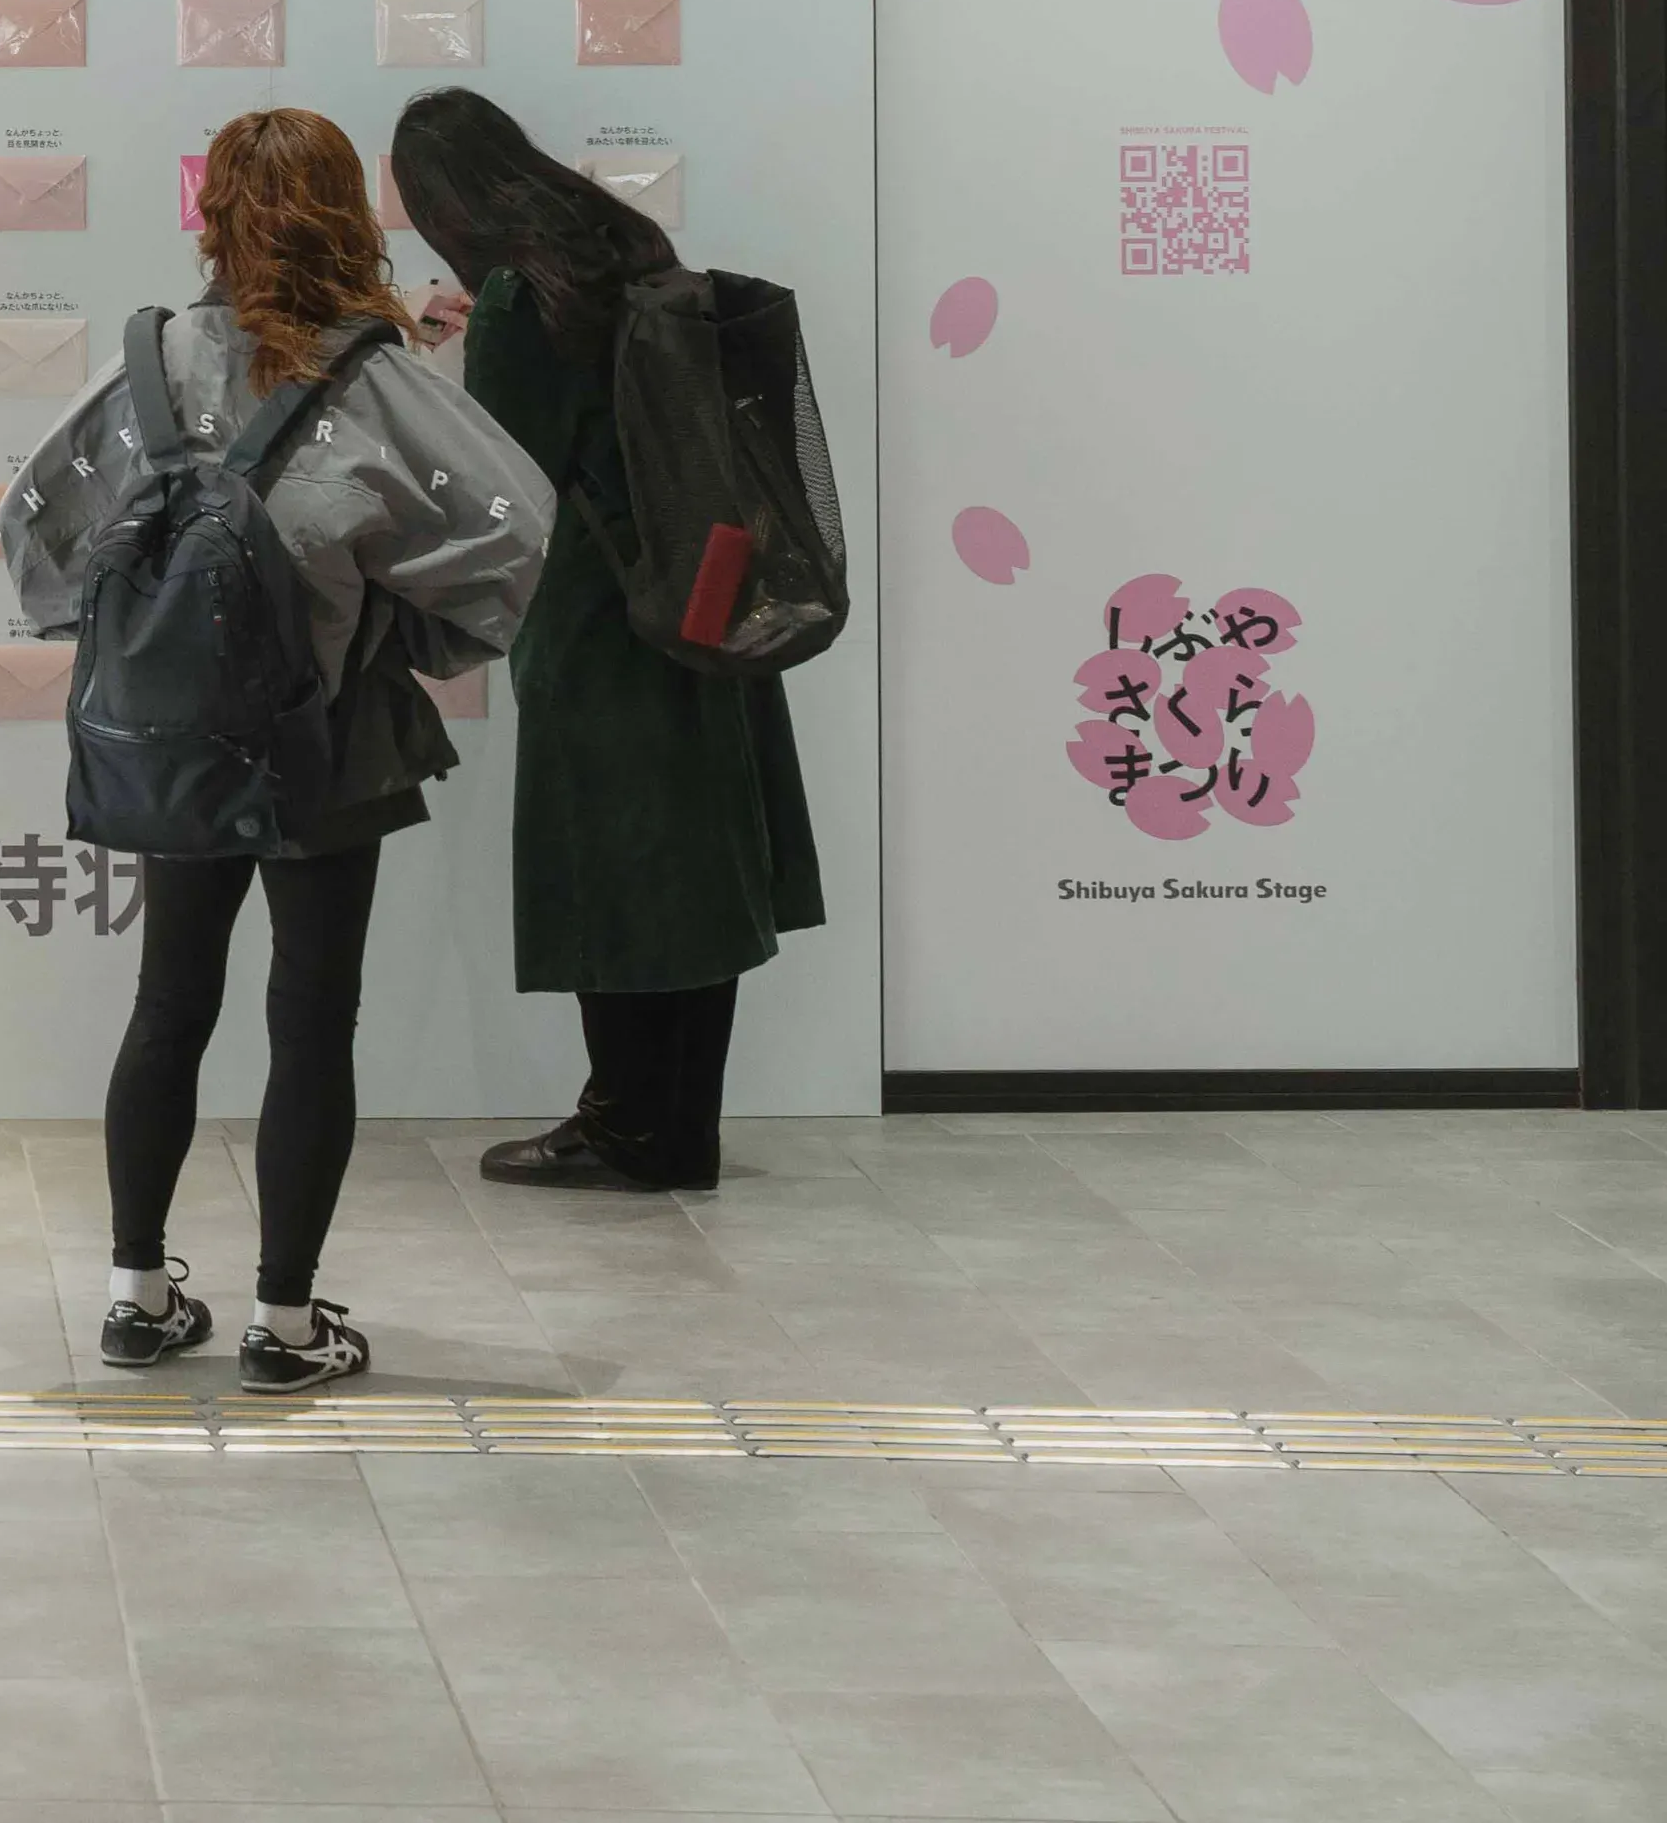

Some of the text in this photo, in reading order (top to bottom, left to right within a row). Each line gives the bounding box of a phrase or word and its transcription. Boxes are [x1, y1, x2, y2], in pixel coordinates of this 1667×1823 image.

[5, 128, 62, 138] なんかちょっと、
[600, 126, 658, 135] なんかちょっと、
[1163, 126, 1202, 135] SAKURA
[7, 139, 62, 149] 目を見開きたい
[5, 291, 64, 301] なんかちょっと、
[1110, 605, 1279, 662] しぶや
[1105, 673, 1264, 738] さくら
[1104, 744, 1271, 808] まつり
[1058, 878, 1328, 903] Shibuya Sakura Stage
